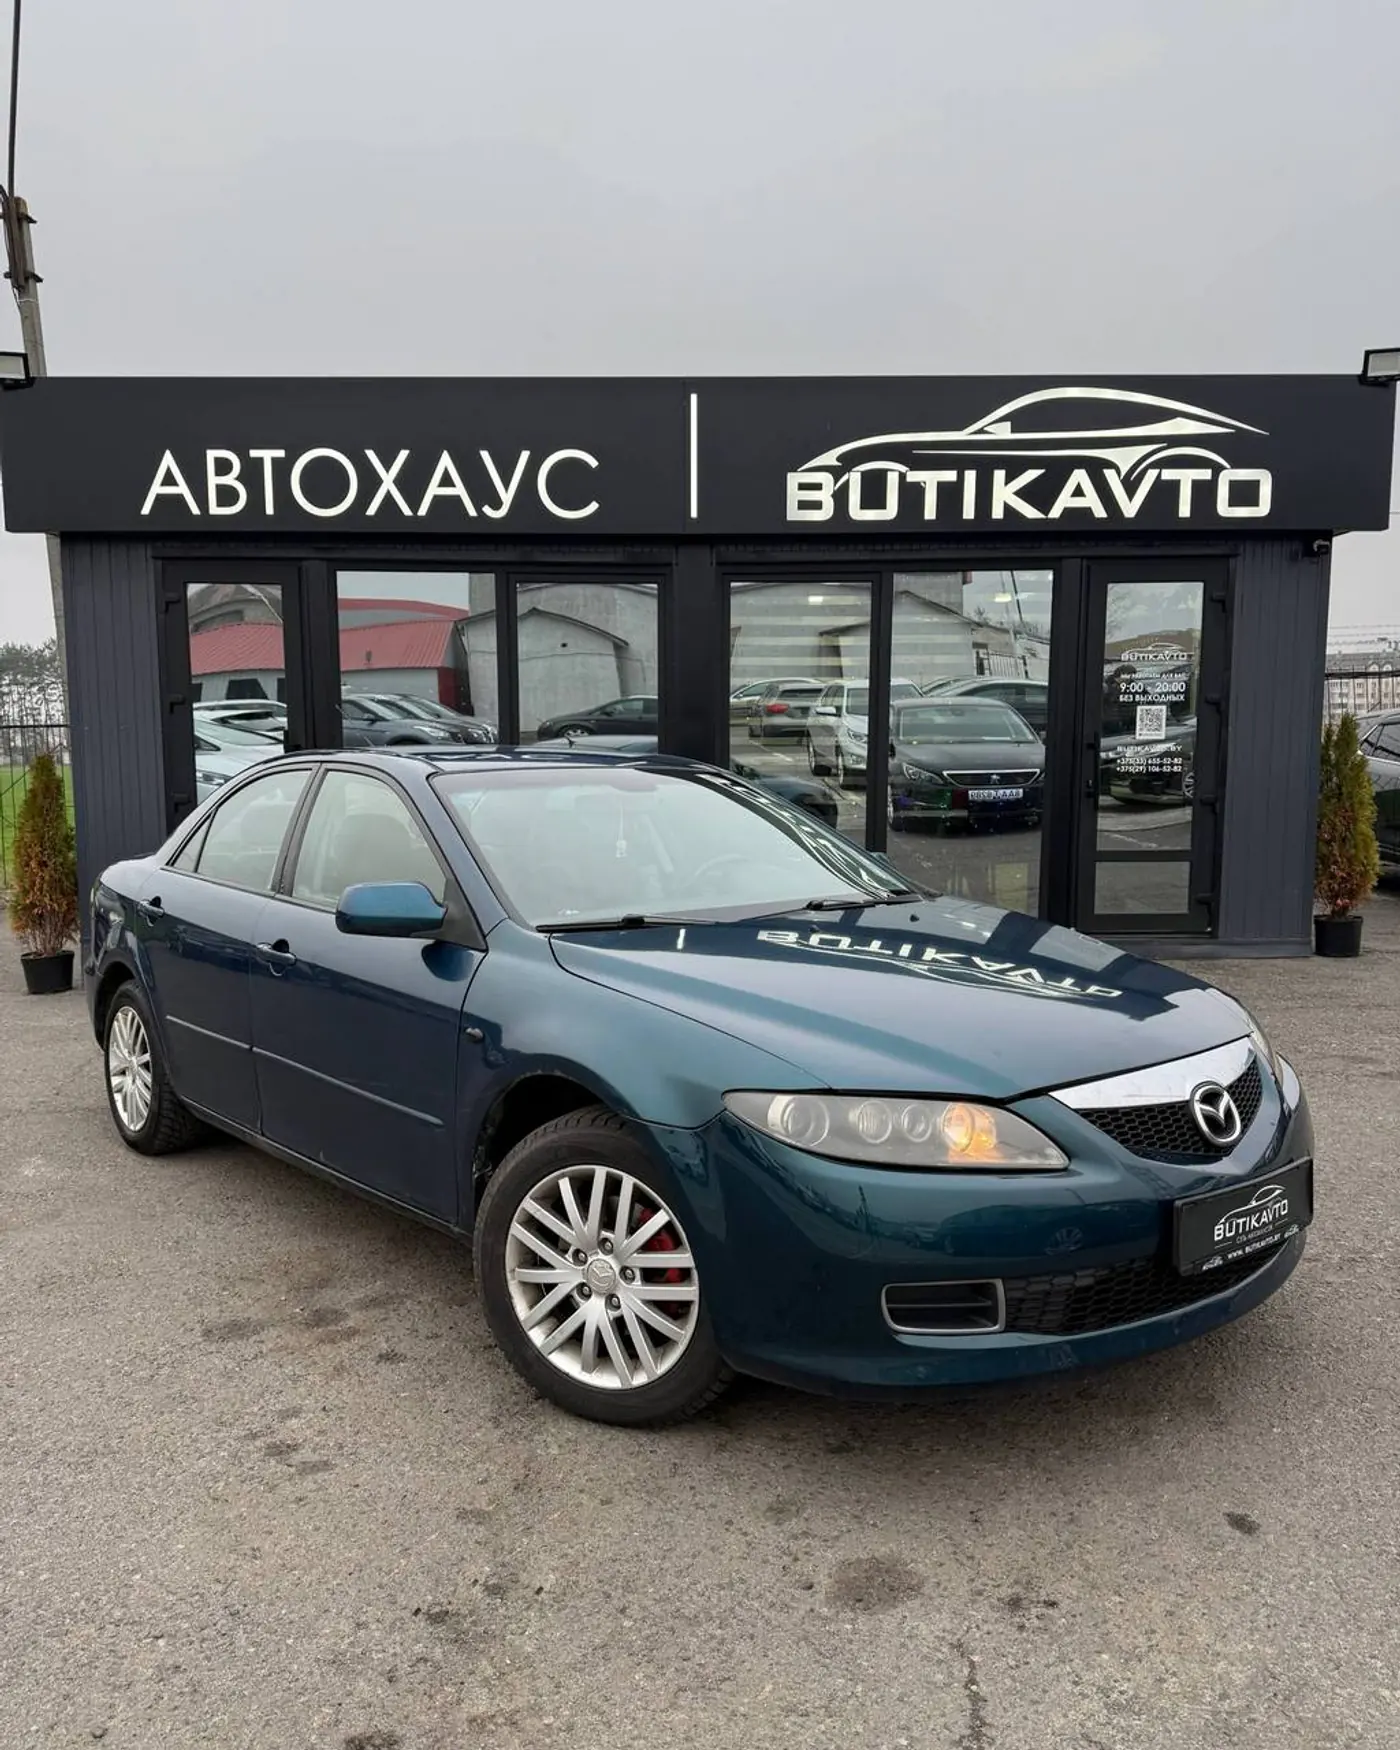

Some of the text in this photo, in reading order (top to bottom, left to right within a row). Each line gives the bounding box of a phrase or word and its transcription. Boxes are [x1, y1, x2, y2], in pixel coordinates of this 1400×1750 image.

[140, 447, 601, 520] АВТОХАУС
[786, 468, 1273, 522] BUTIKAVTO
[1121, 652, 1188, 662] BUTIKAVTO
[1119, 682, 1144, 692] 9:00
[1155, 682, 1186, 692] 20:00
[1119, 694, 1185, 703] БЕЗ ВЫХОДНЫХ
[1214, 1198, 1289, 1242] BUTIKAVTO
